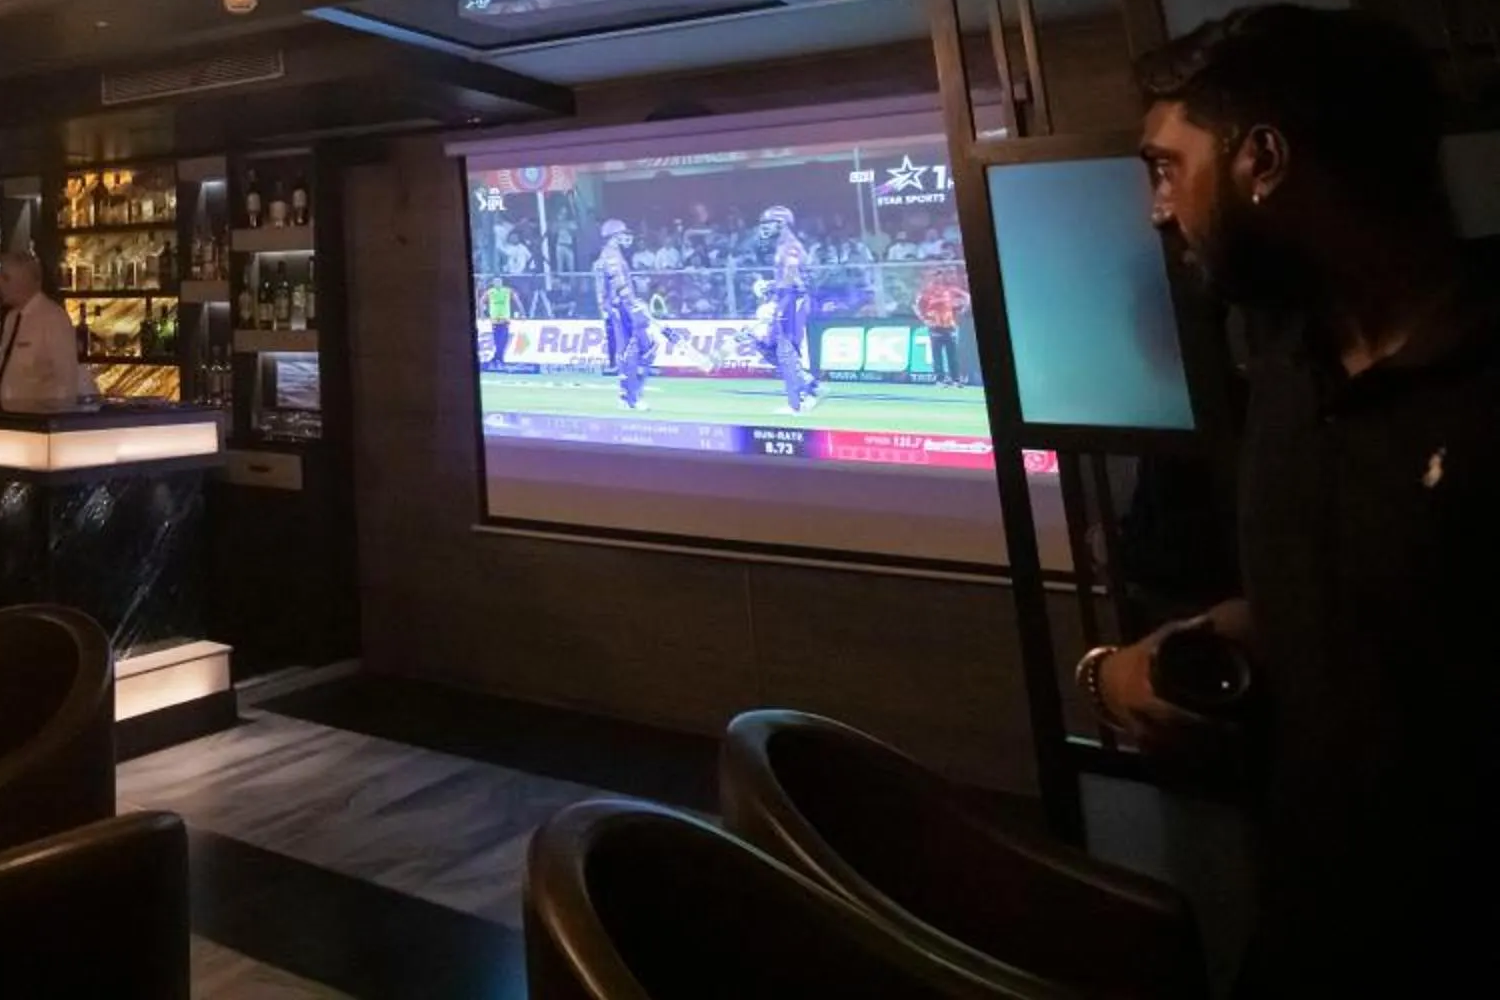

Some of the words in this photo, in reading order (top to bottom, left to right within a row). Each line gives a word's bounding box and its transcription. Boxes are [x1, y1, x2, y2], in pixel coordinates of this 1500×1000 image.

[932, 165, 946, 190] 1
[877, 196, 903, 206] STAR
[906, 193, 945, 204] SPORTS
[536, 326, 607, 354] RuP
[663, 327, 759, 357] RuPa
